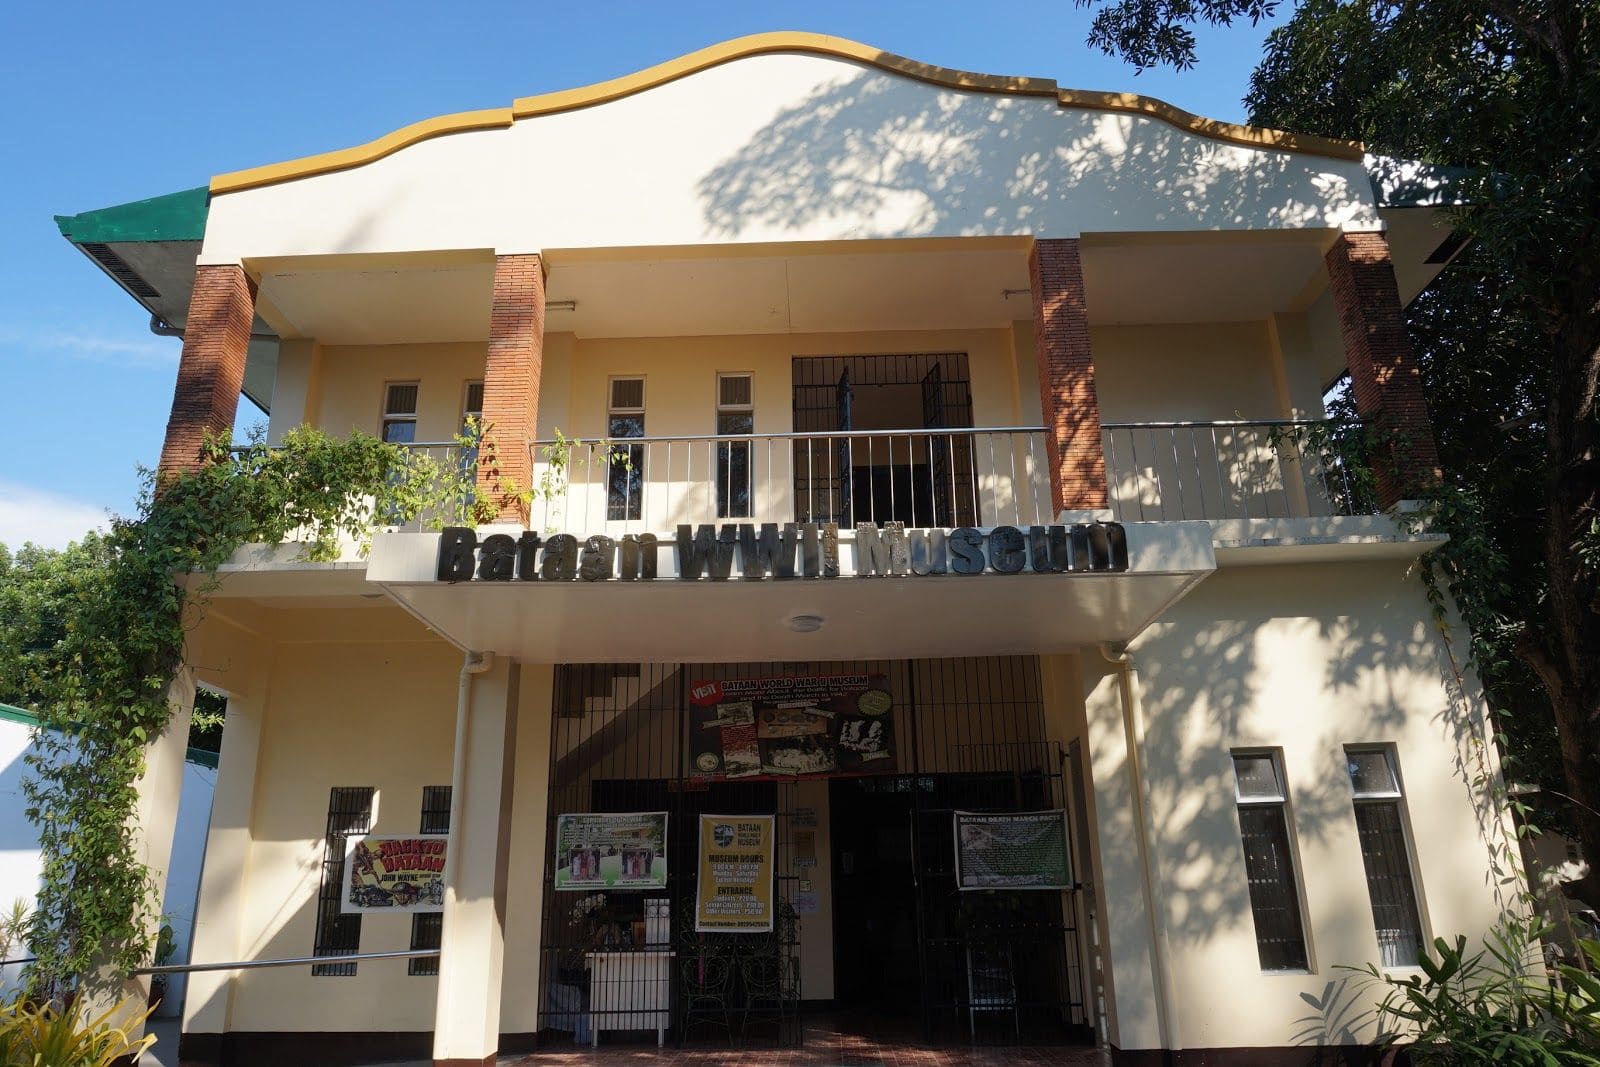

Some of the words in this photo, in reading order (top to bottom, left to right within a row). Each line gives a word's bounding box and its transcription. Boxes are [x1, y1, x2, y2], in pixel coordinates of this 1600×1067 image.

[436, 526, 658, 582] Bataan
[677, 521, 840, 580] WWII
[856, 520, 1130, 577] Museum
[759, 677, 793, 689] WORLD
[795, 677, 817, 688] WAR
[829, 675, 868, 687] MUSEUM
[988, 815, 1011, 823] DEATH
[380, 840, 424, 857] BACK
[424, 841, 444, 854] TO
[383, 855, 446, 873] BATAAN
[708, 855, 739, 863] MUSEUM
[381, 874, 396, 882] JOHN
[397, 873, 418, 882] WAYNE
[718, 887, 753, 895] ENTRANCE
